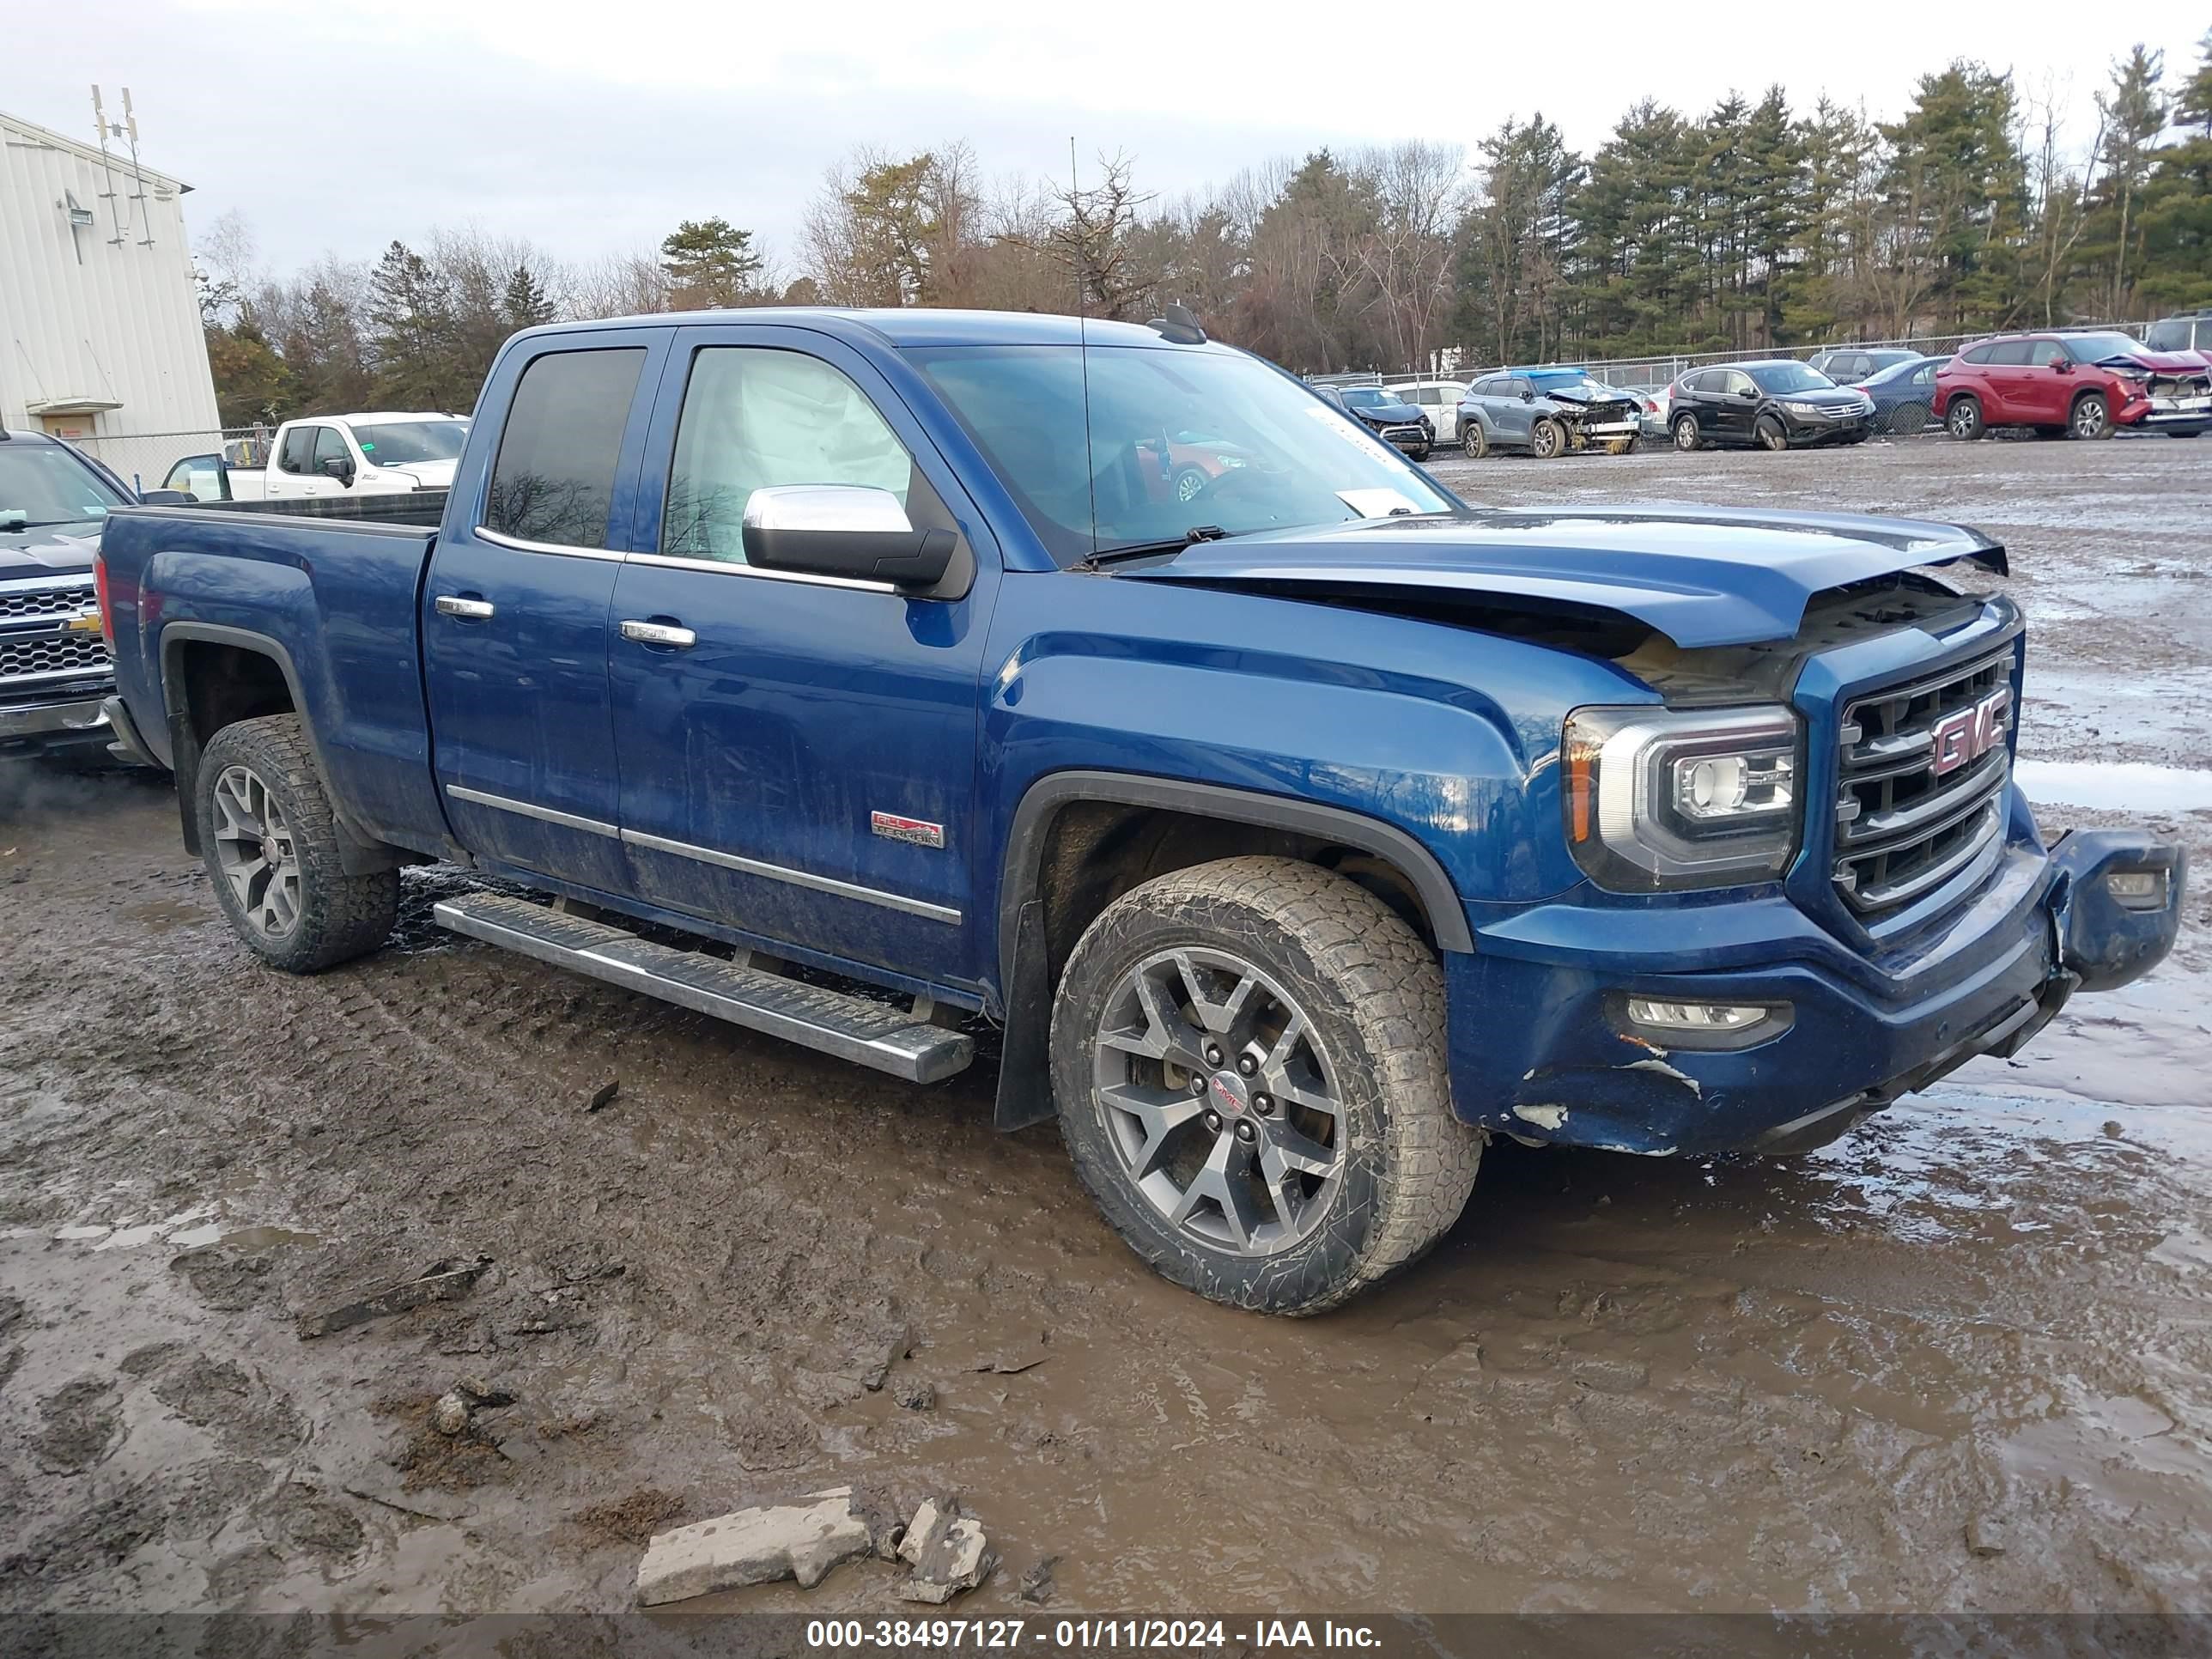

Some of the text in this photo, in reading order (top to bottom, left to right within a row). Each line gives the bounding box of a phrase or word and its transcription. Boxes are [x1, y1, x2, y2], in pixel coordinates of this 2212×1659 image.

[1932, 690, 2007, 775] GMC
[877, 815, 906, 828] ALL
[874, 825, 940, 847] TERRAIN
[1212, 1078, 1243, 1111] GMC
